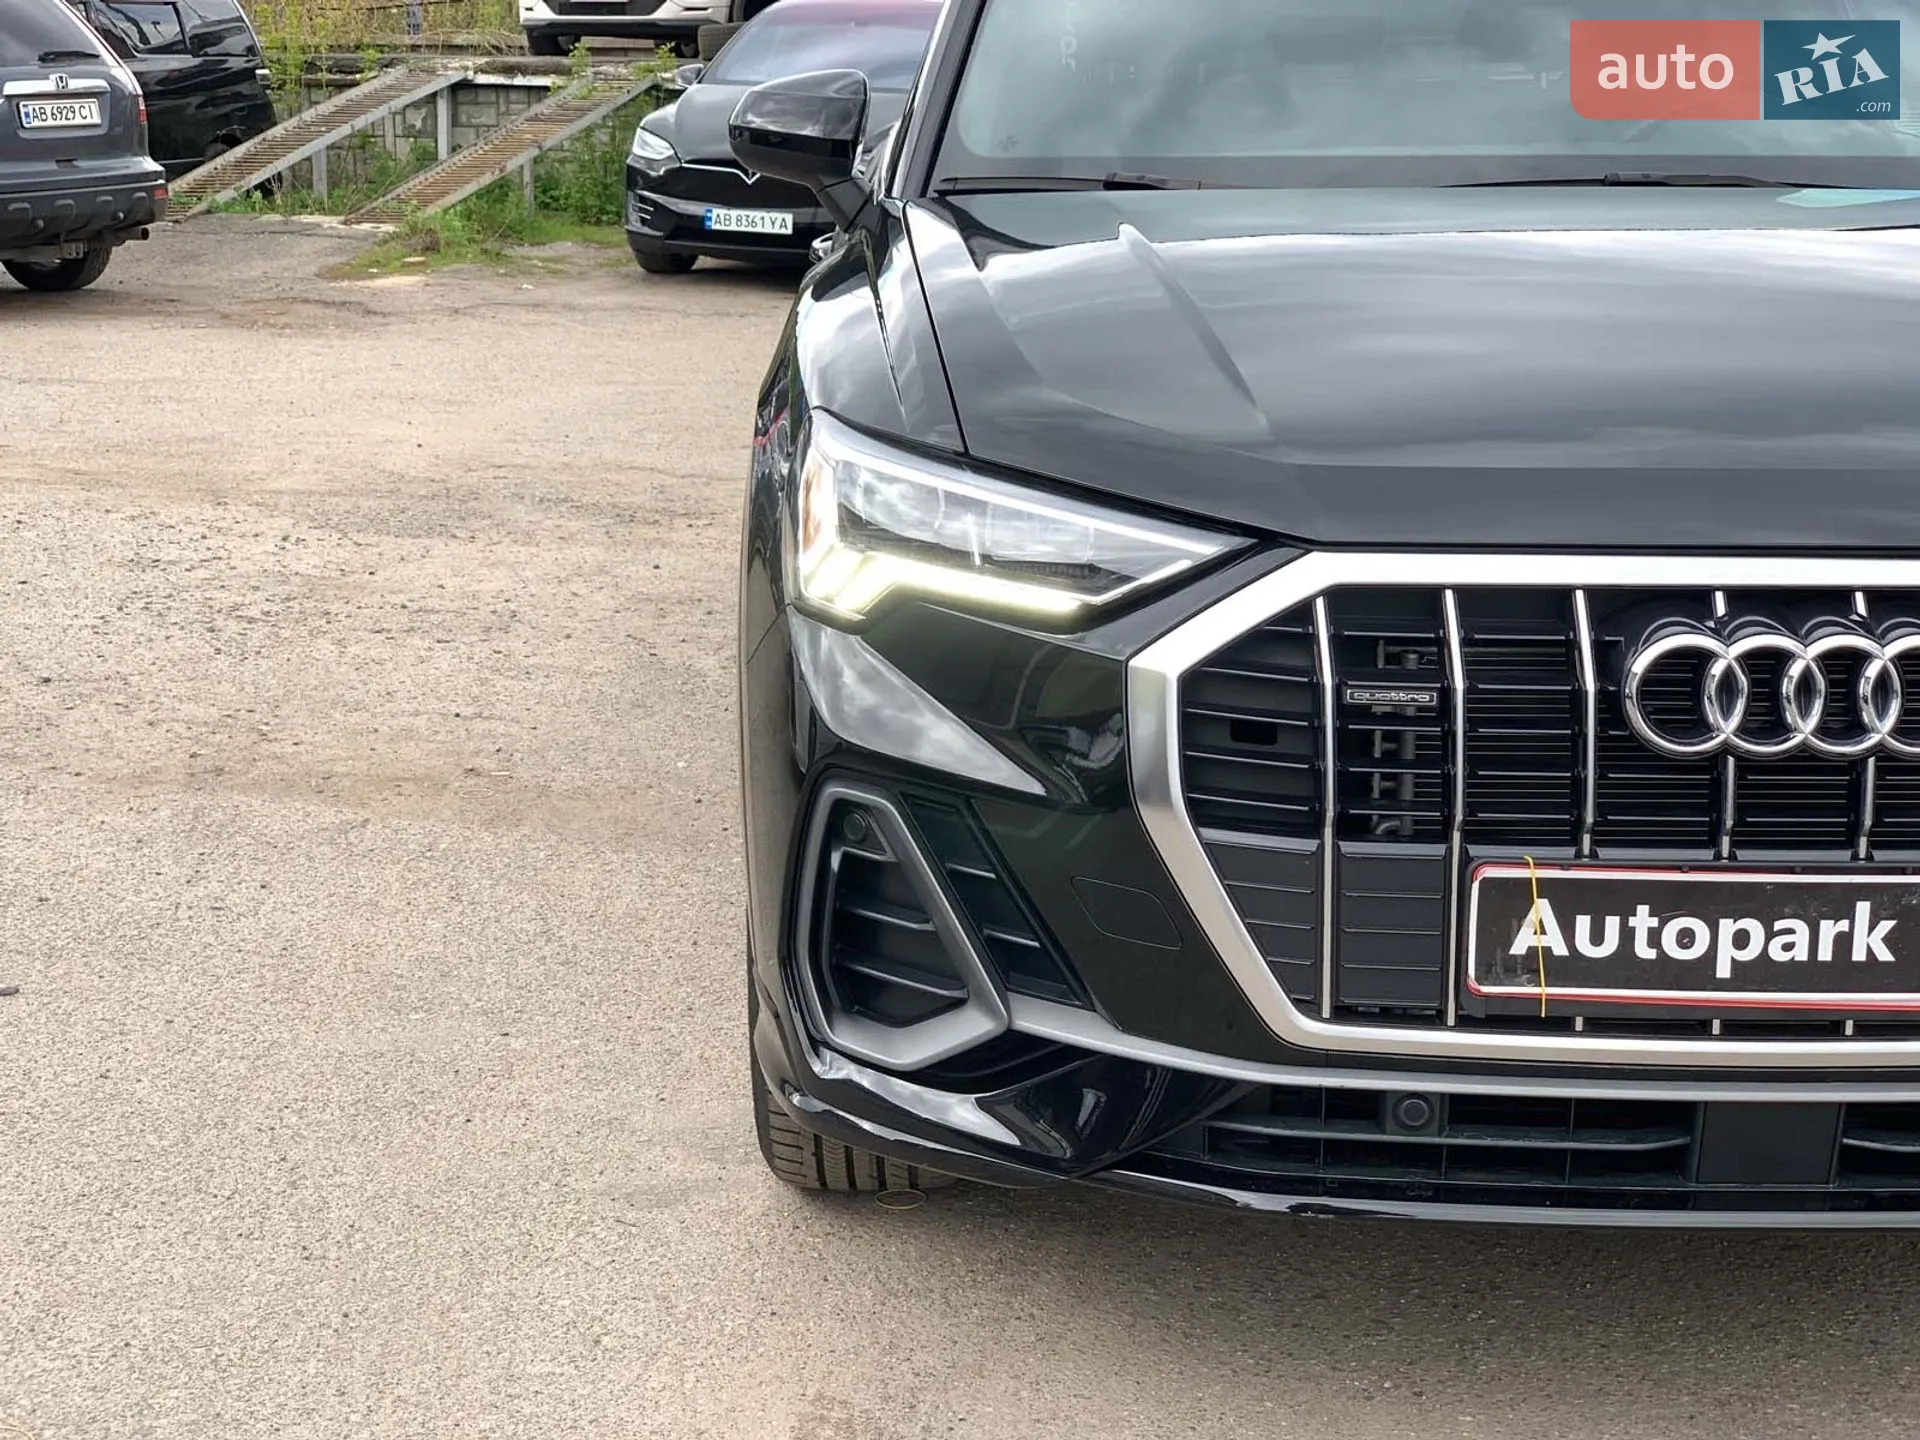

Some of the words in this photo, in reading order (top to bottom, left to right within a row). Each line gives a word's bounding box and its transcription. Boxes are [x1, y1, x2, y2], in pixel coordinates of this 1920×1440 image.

[32, 106, 48, 122] AB
[51, 105, 76, 121] 6929
[78, 104, 94, 120] CI
[714, 213, 732, 227] AB
[735, 214, 765, 229] 8361
[769, 216, 789, 231] YA
[1353, 691, 1430, 702] quattro
[1508, 898, 1898, 978] Autopark
